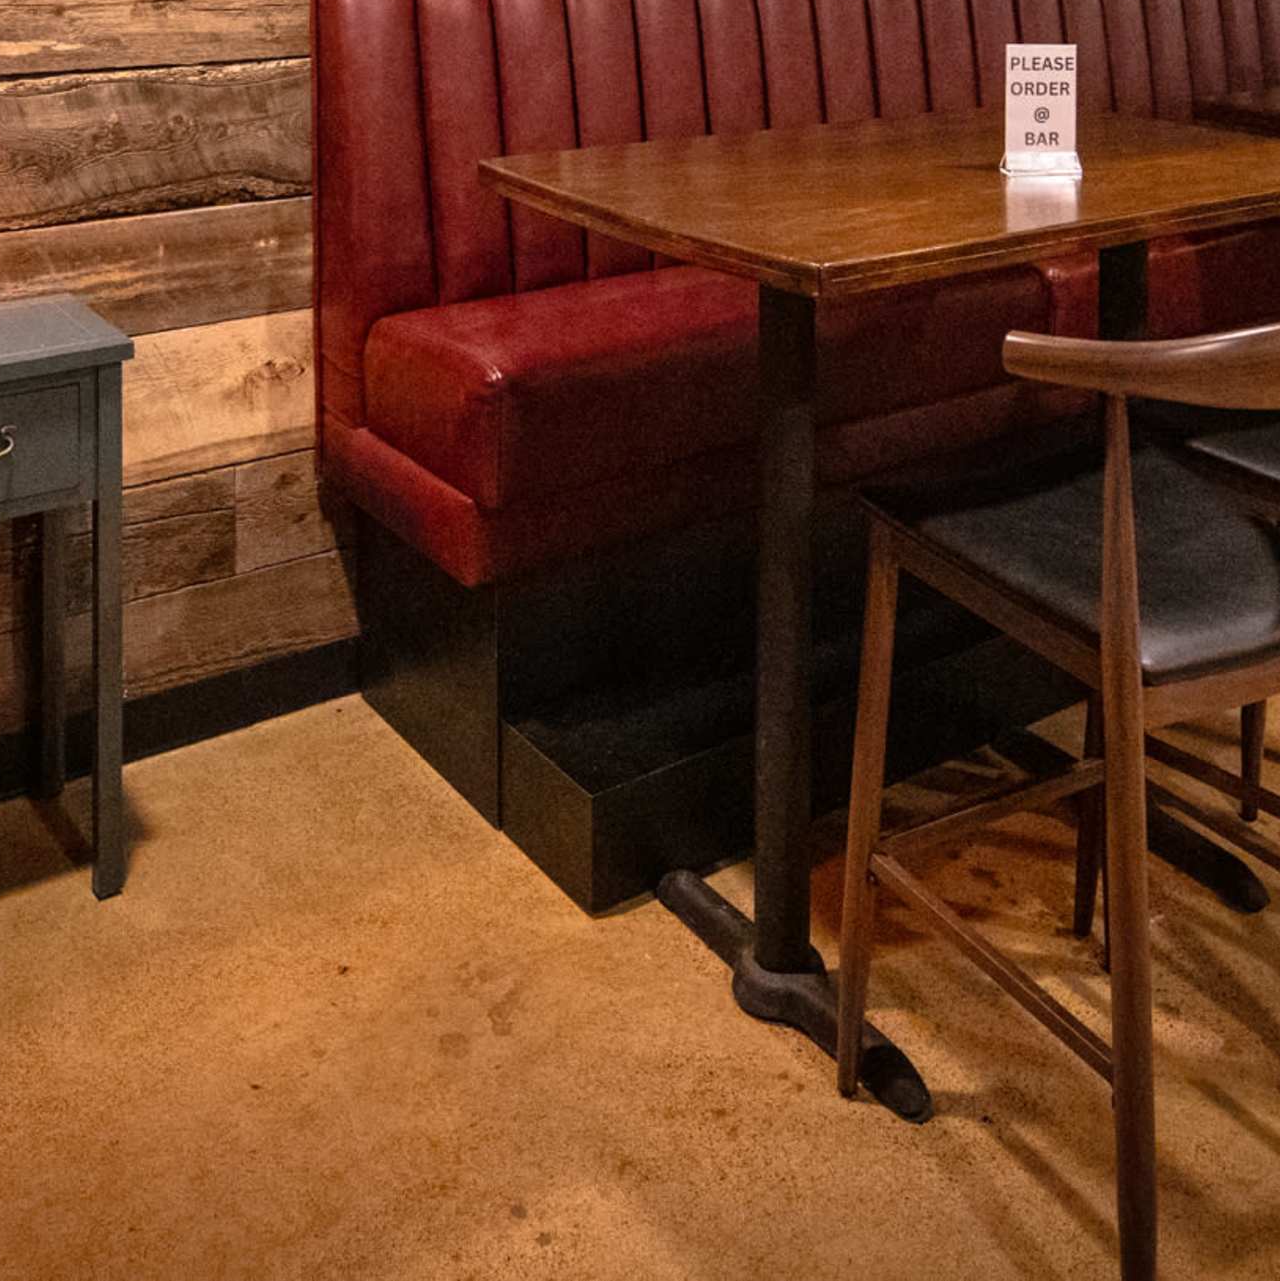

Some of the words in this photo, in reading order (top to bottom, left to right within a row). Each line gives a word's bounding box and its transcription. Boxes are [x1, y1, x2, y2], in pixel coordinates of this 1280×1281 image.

[1010, 56, 1074, 71] PLEASE
[1010, 81, 1070, 96] ORDER
[1033, 106, 1050, 123] @
[1024, 131, 1060, 146] BAR
